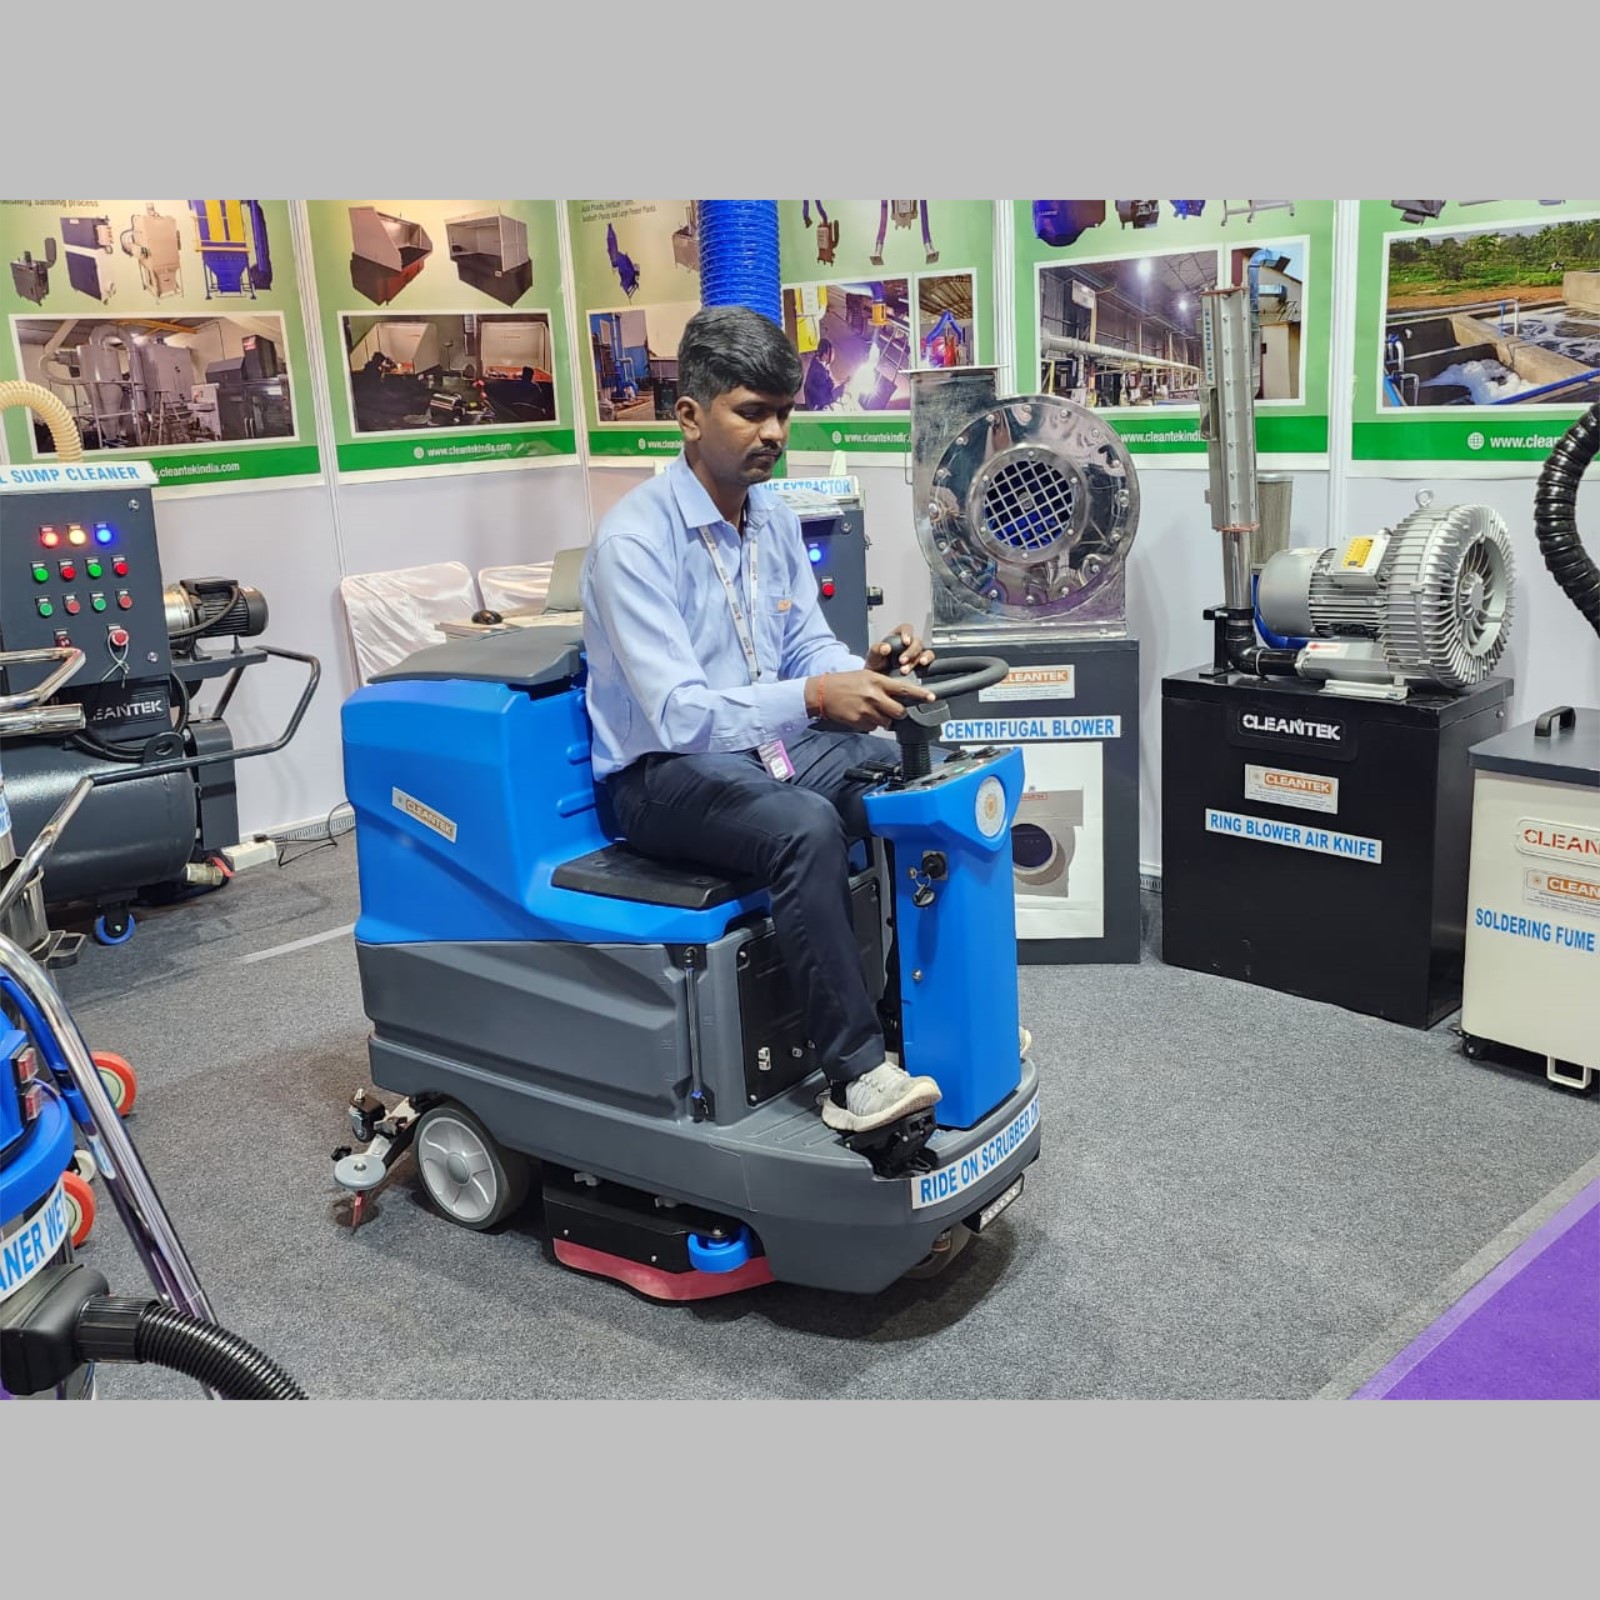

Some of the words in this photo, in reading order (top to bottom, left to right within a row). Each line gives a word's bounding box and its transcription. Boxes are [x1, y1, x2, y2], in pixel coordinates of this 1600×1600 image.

[11, 469, 59, 483] SUMP
[66, 466, 140, 480] CLEANER
[945, 720, 1048, 739] CENTRIFUGAL
[1053, 719, 1114, 736] BLOWER
[1242, 714, 1340, 740] CLEANTEK
[1265, 774, 1331, 794] CLEANTEK
[406, 800, 453, 835] CLEANTEK
[1211, 813, 1242, 832] RING
[1246, 820, 1301, 843] BLOWER
[1305, 831, 1328, 849] AIR
[1334, 836, 1376, 859] KNIFE
[1476, 907, 1552, 942] SOLDERING
[1556, 926, 1595, 952] FUME
[920, 1167, 958, 1203] RIDE
[961, 1153, 979, 1185] ON
[982, 1110, 1030, 1171] SCRUBBER
